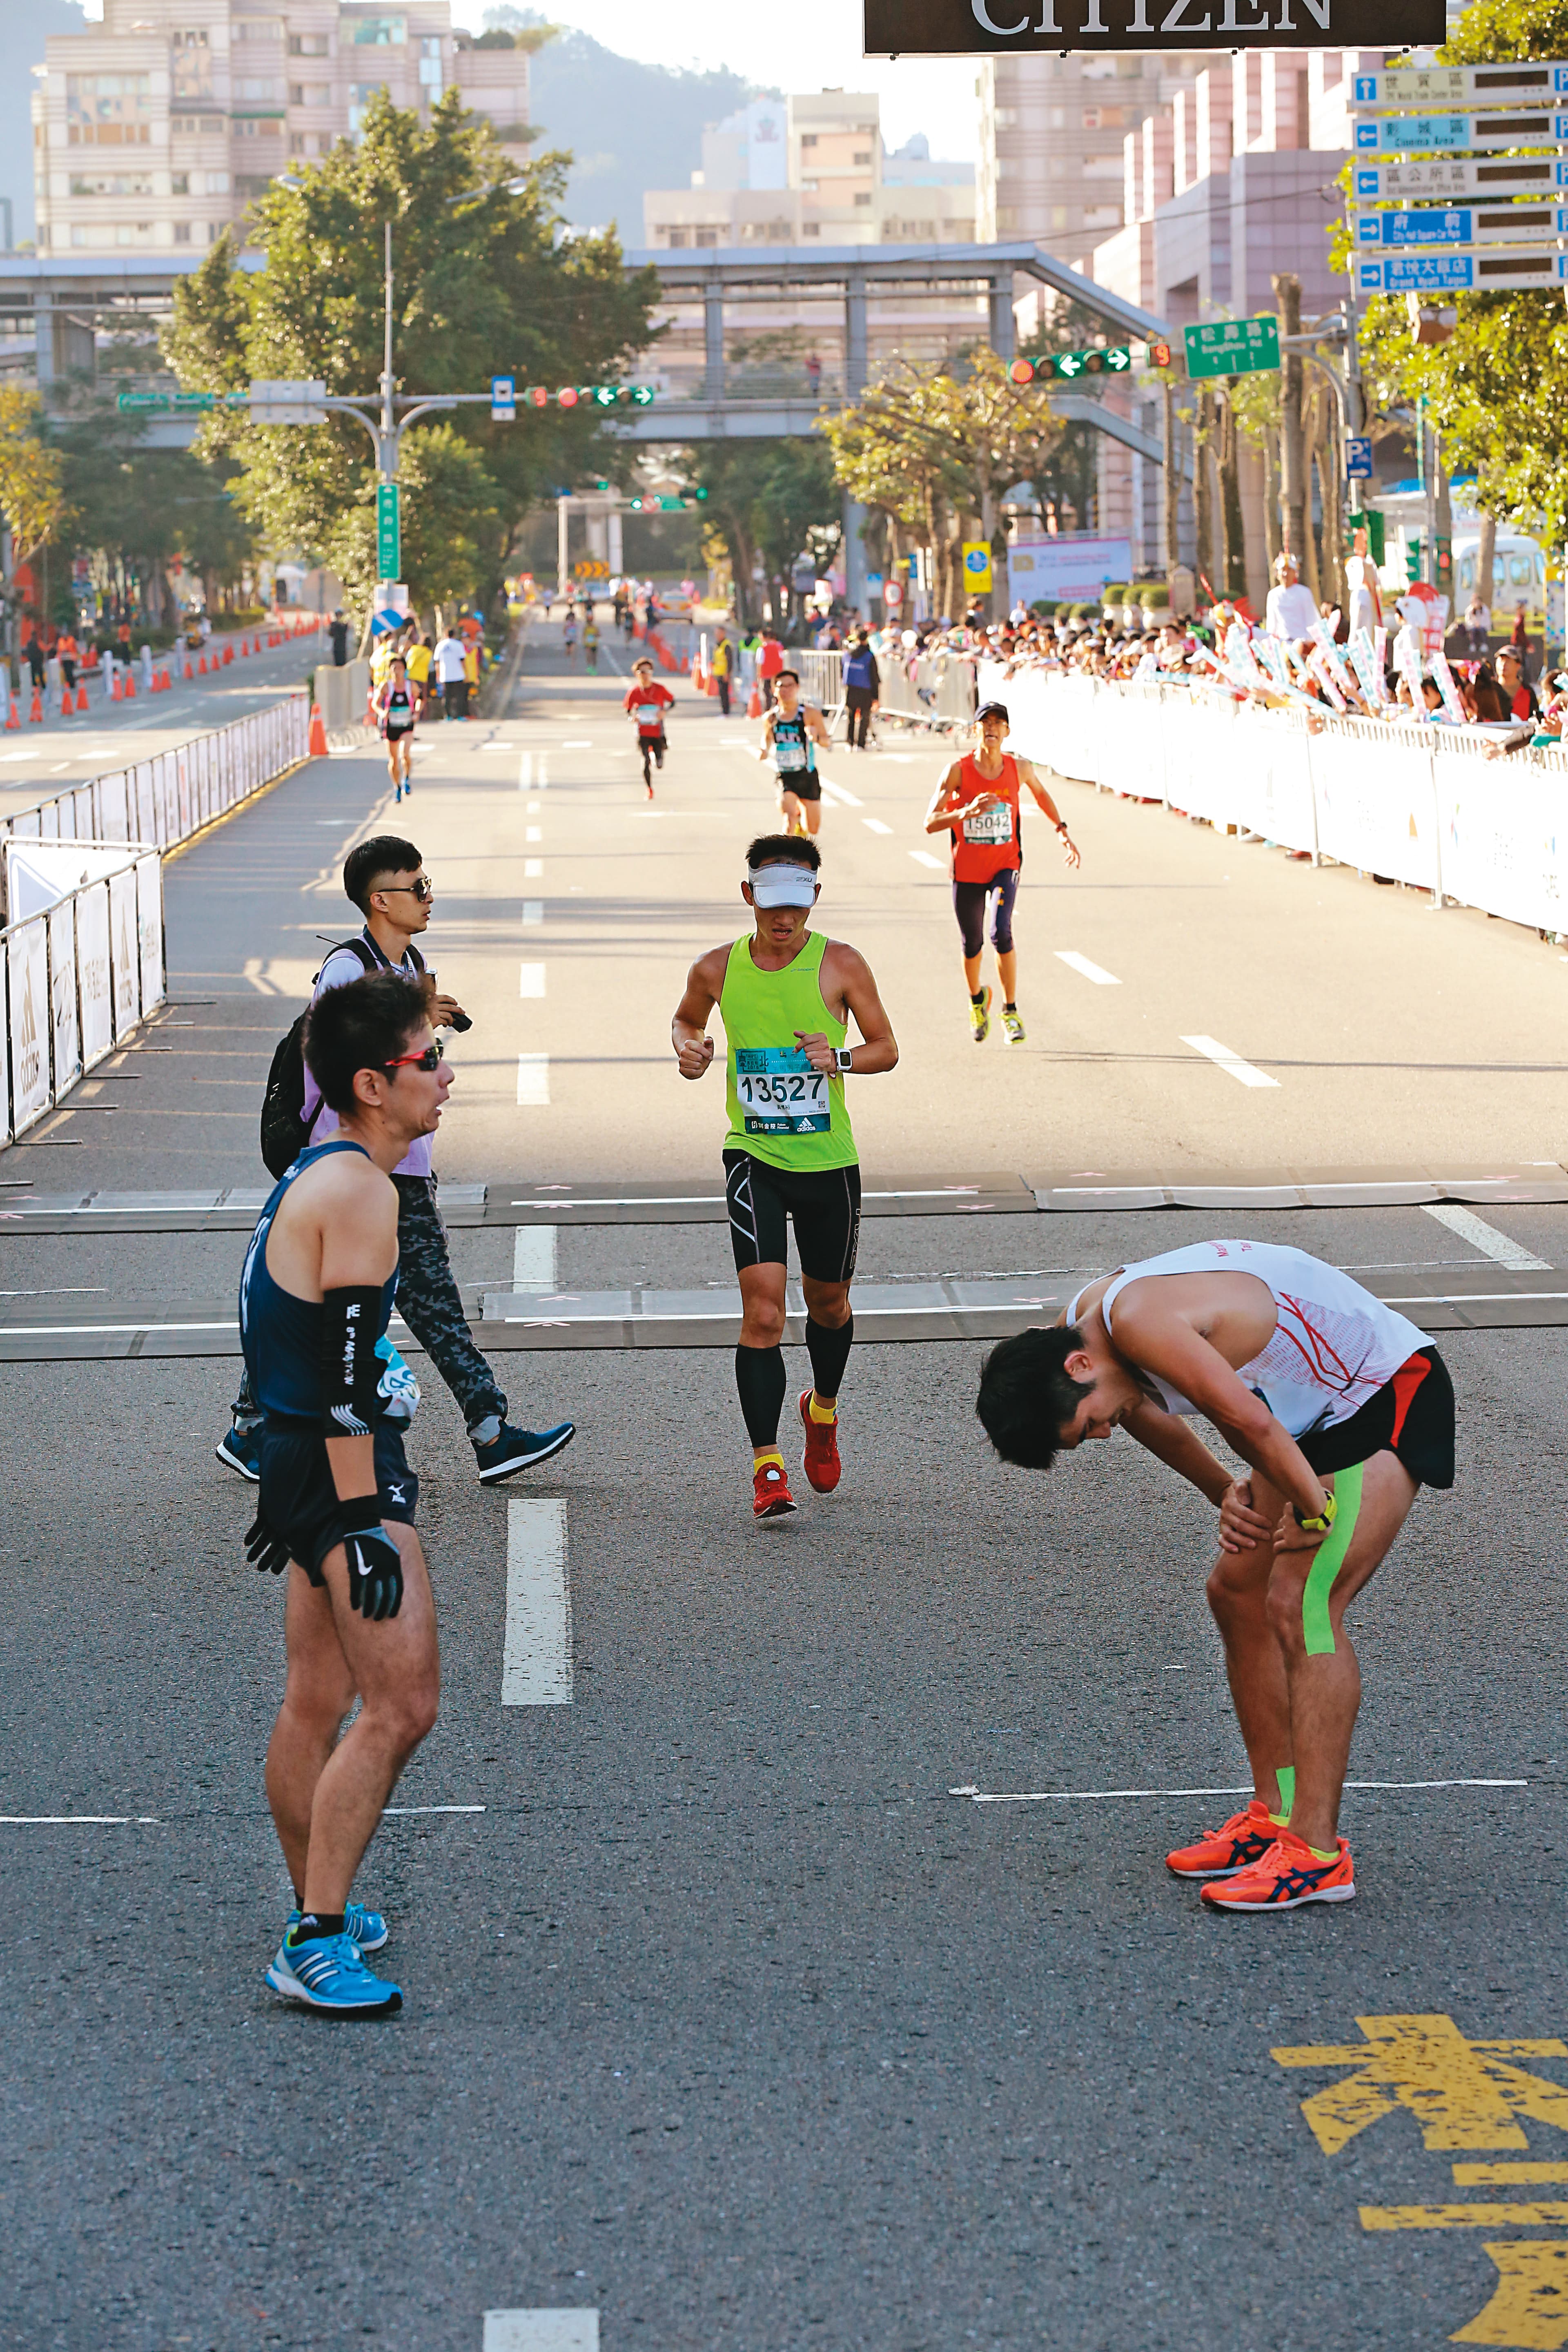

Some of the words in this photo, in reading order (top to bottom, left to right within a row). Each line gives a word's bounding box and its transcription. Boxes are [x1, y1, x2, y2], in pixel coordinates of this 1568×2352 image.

[1155, 343, 1170, 366] 9
[1346, 441, 1363, 464] P
[968, 815, 1009, 829] 15042
[742, 1074, 824, 1102] 13527
